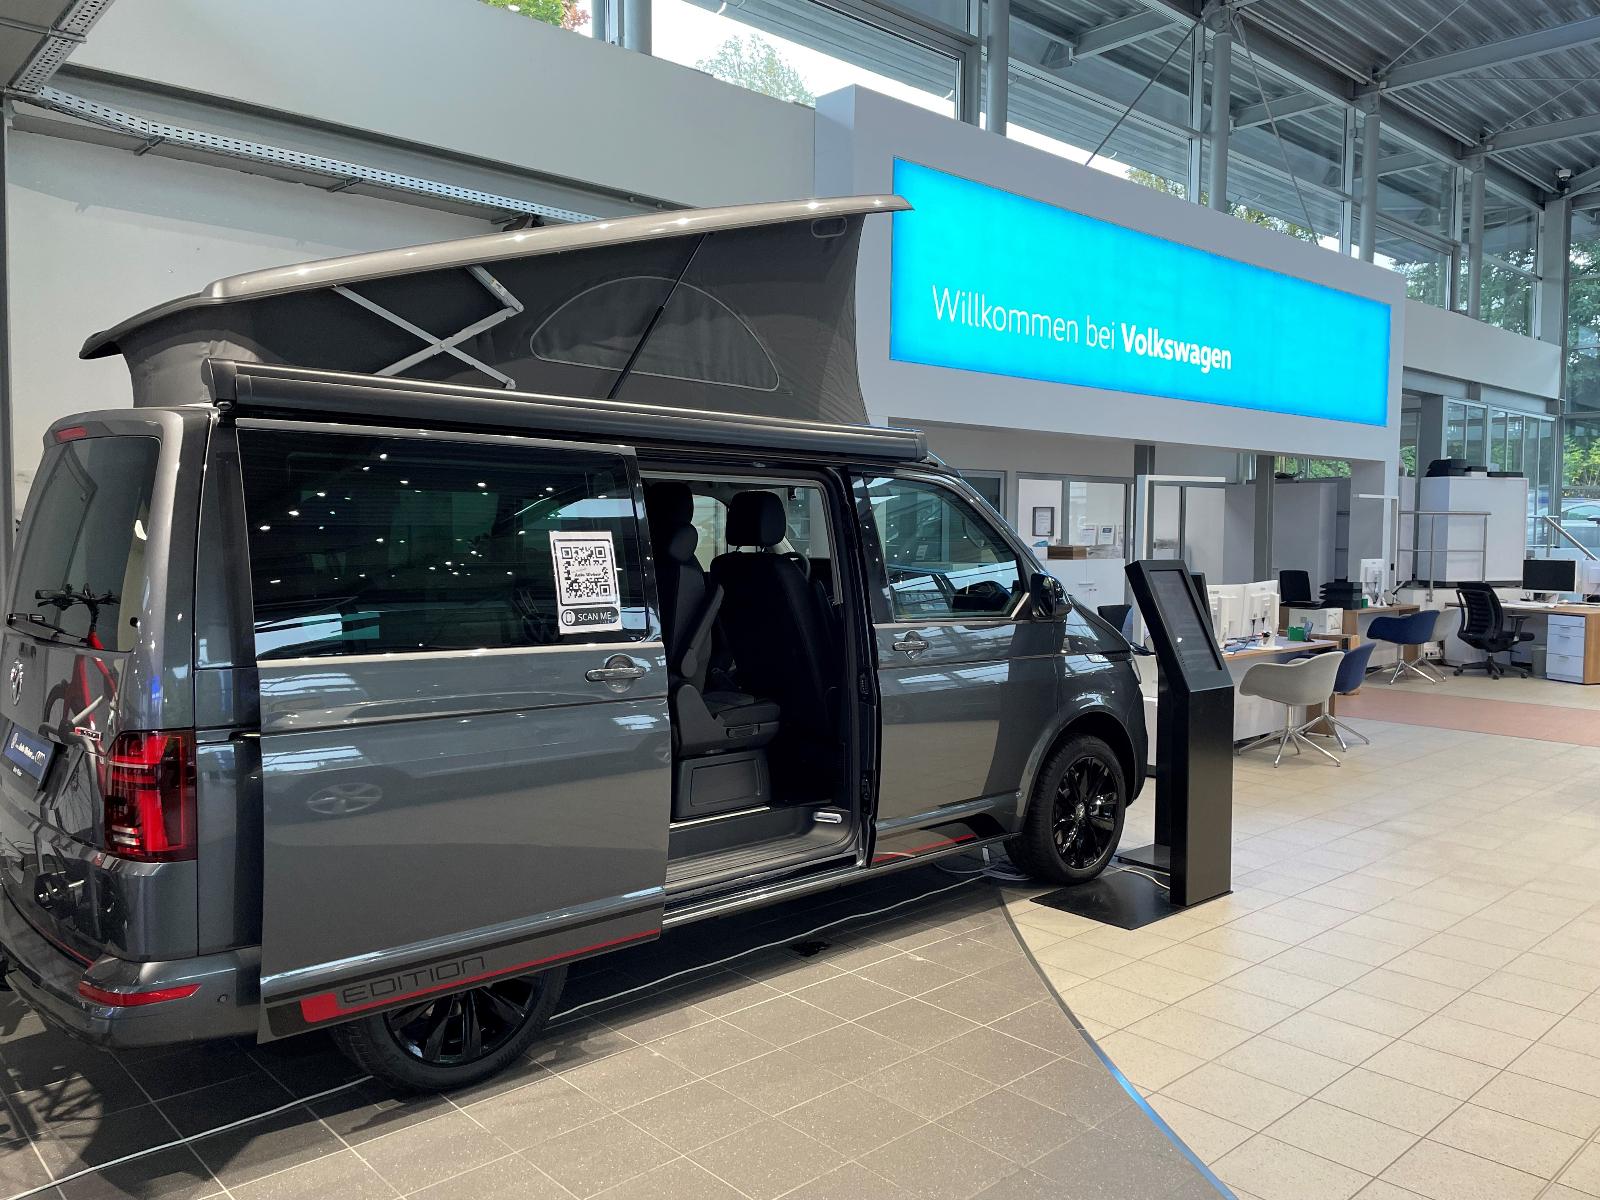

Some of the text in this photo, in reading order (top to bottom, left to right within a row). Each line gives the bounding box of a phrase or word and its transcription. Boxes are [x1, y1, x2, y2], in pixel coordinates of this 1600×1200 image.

[932, 285, 1232, 373] Willkommen bei Volkswagen
[577, 611, 612, 622] SCAN ME
[342, 956, 486, 1004] EDITION
